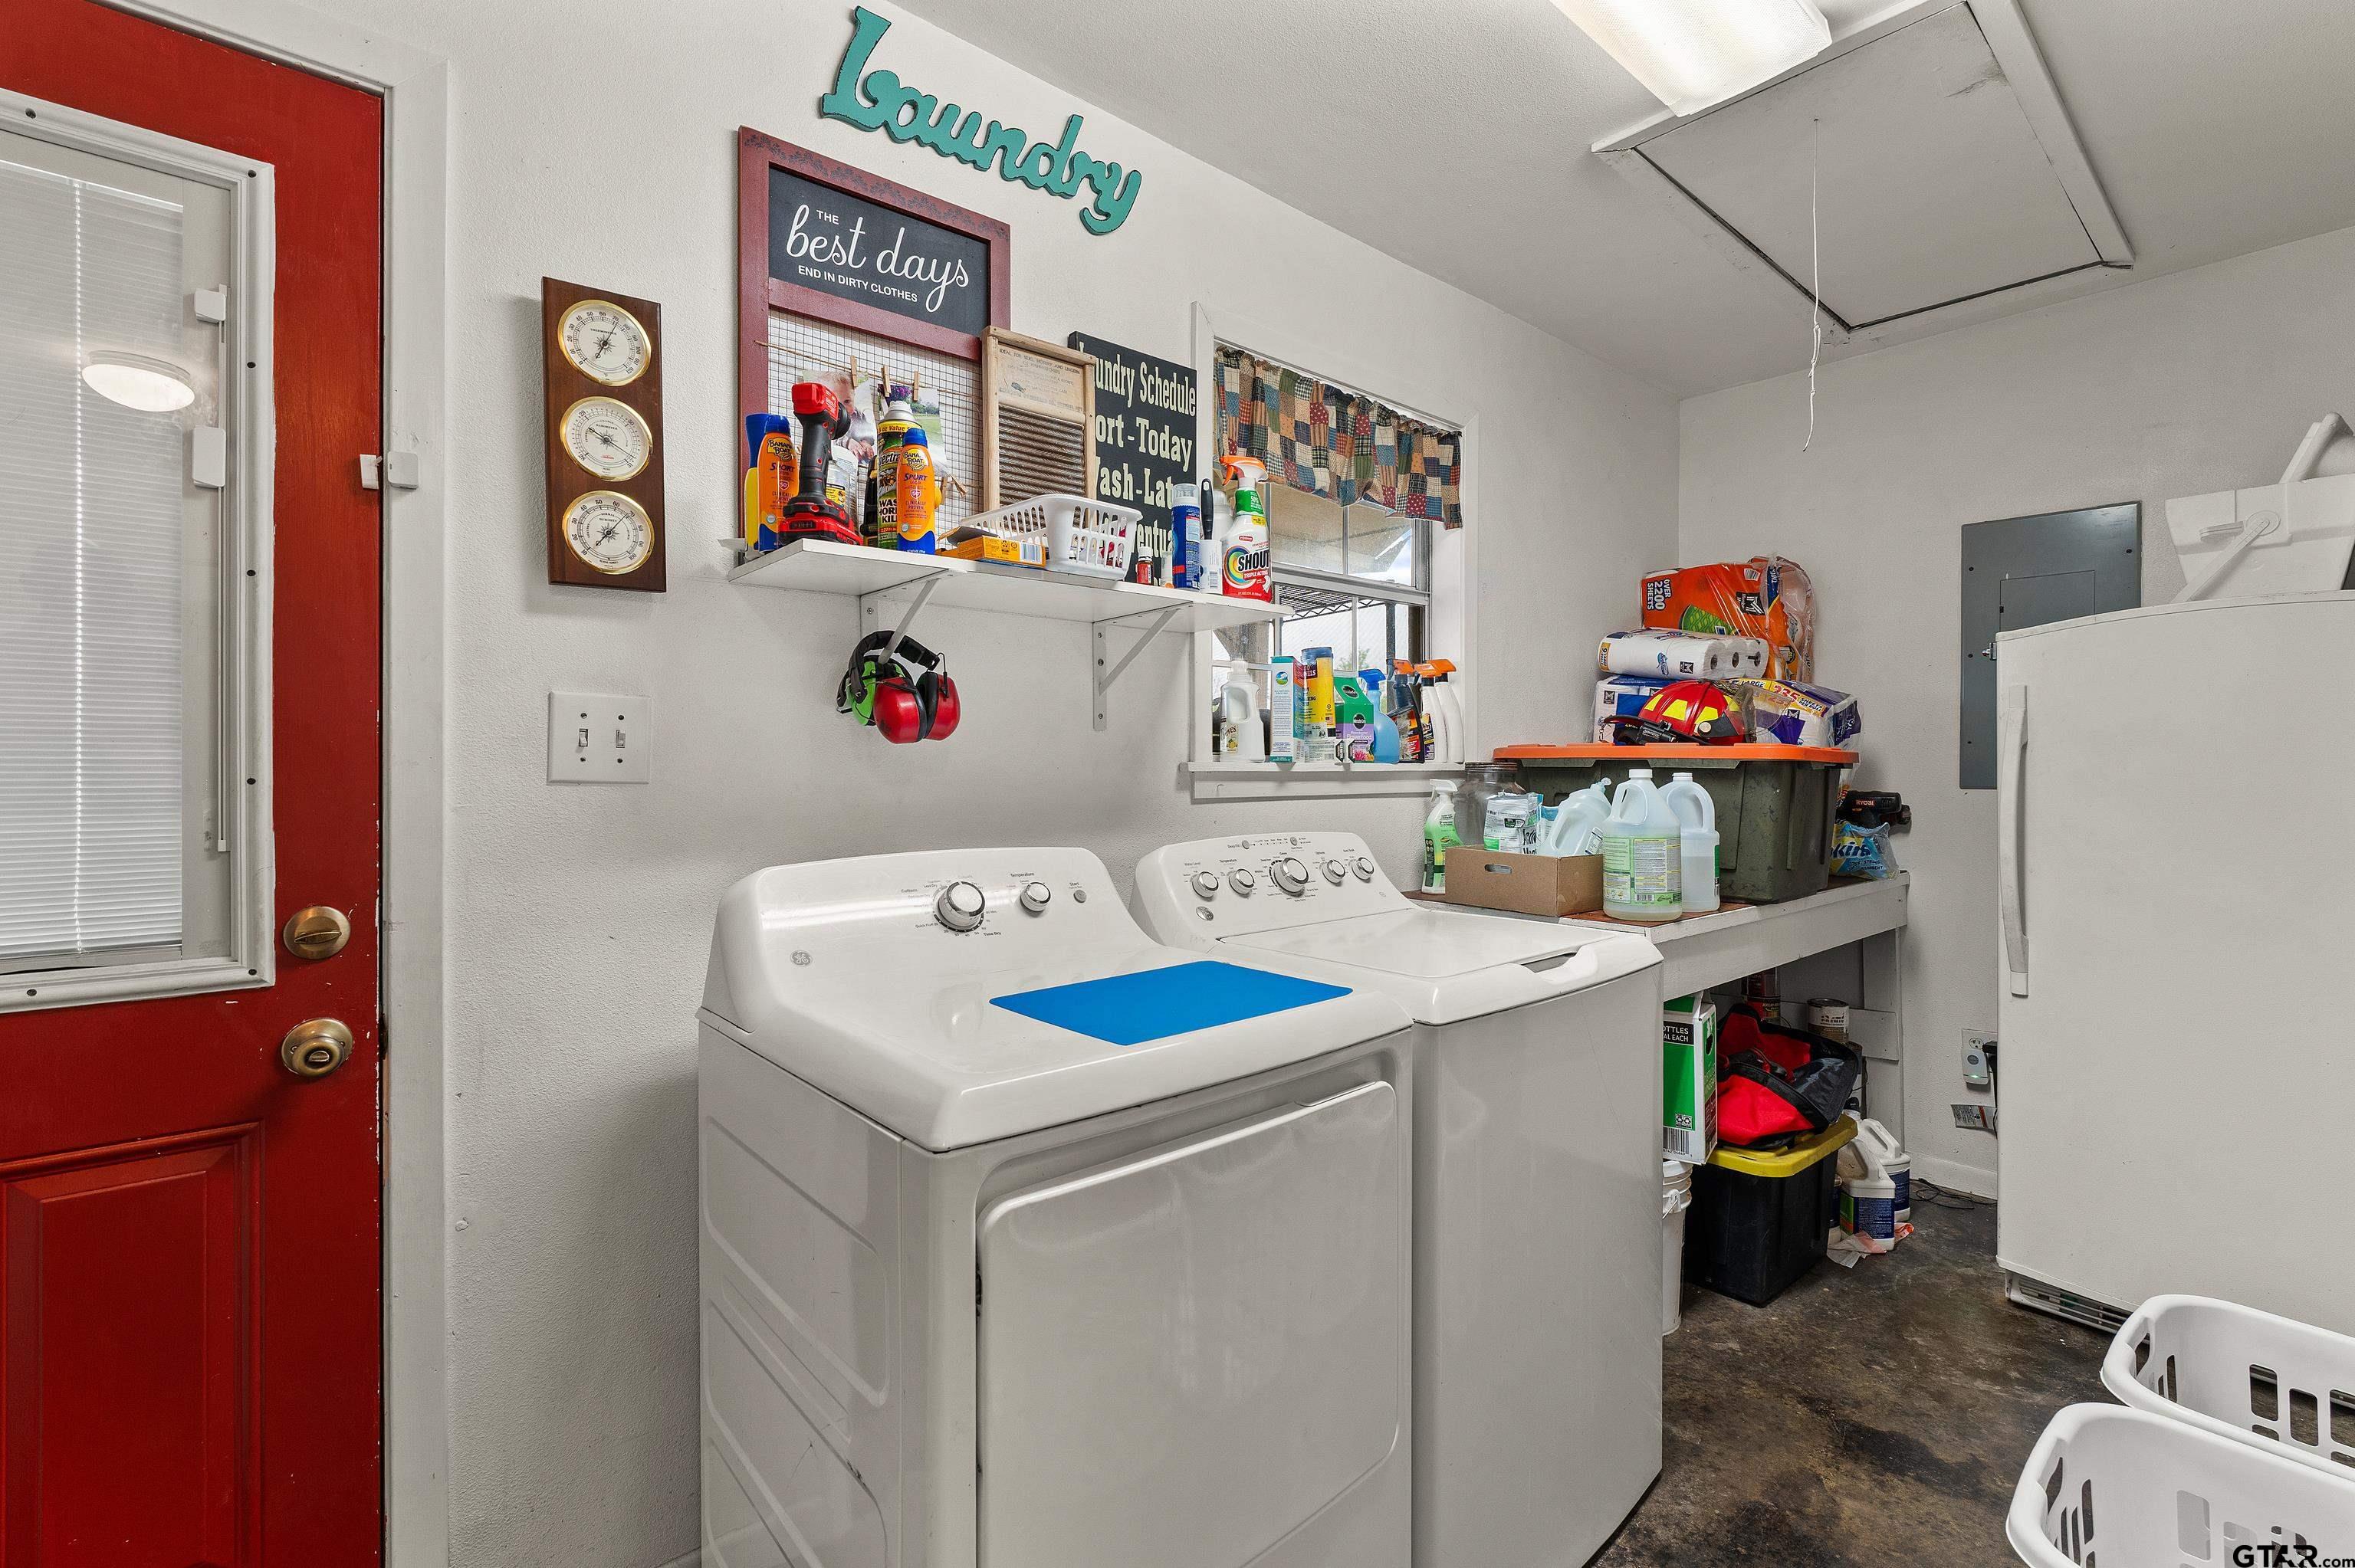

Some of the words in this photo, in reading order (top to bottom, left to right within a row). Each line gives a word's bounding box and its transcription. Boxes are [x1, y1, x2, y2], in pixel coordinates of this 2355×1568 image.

[822, 5, 1142, 235] Laundry
[816, 209, 839, 225] THE
[786, 204, 867, 269] best
[876, 227, 969, 313] days
[798, 265, 822, 279] END
[824, 271, 836, 283] IN
[838, 275, 869, 290] DIRTY
[871, 283, 918, 303] CLOTHES
[1094, 353, 1135, 408] undry
[1140, 361, 1196, 417] Schedule
[769, 439, 793, 449] BANANA
[774, 446, 790, 455] BOAT
[1095, 414, 1124, 448] ort
[1135, 416, 1193, 472] Today
[1144, 467, 1173, 510] Lat
[1238, 549, 1269, 571] SHOUT
[1654, 581, 1666, 610] 2200
[1664, 579, 1672, 598] OVER
[1664, 1025, 1689, 1034] OTTLES
